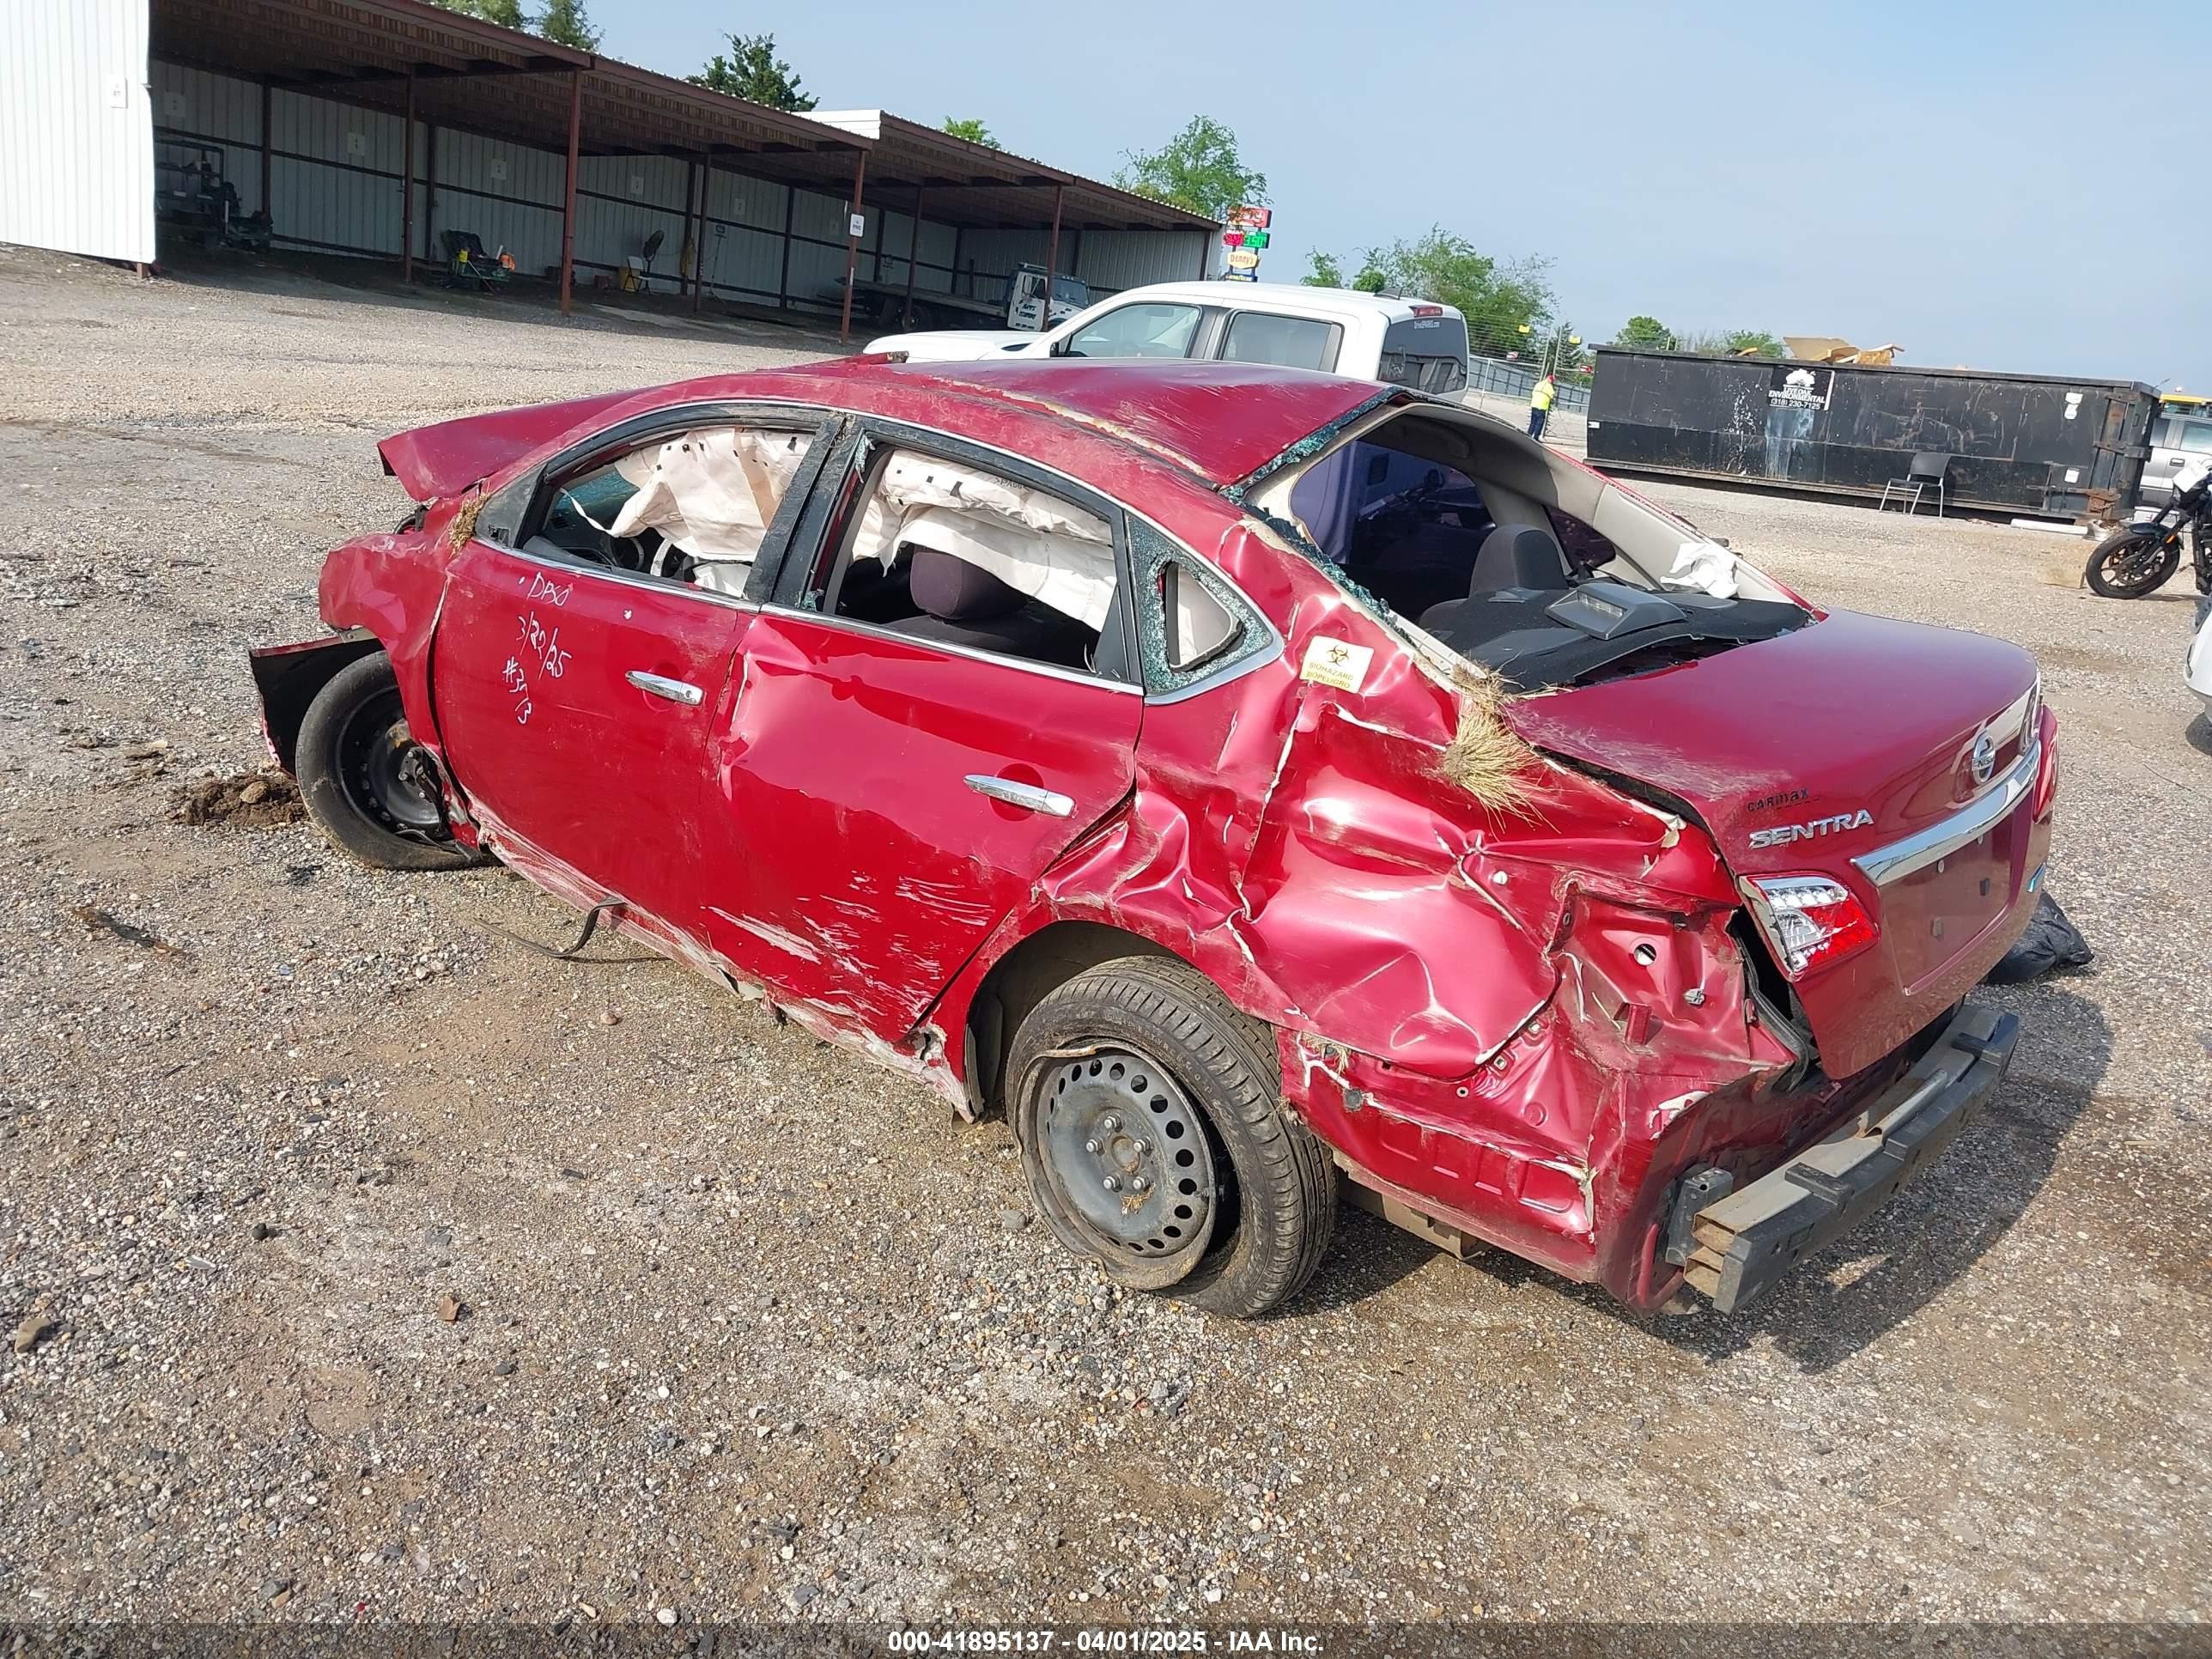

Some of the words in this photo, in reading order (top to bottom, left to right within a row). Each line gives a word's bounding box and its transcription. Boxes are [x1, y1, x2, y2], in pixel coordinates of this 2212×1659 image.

[1768, 390, 1826, 404] ENVIRONMENTAL
[1789, 400, 1821, 410] 230-7125
[1305, 671, 1351, 689] BIOPELIGRO
[1747, 809, 1875, 850] SENTRA
